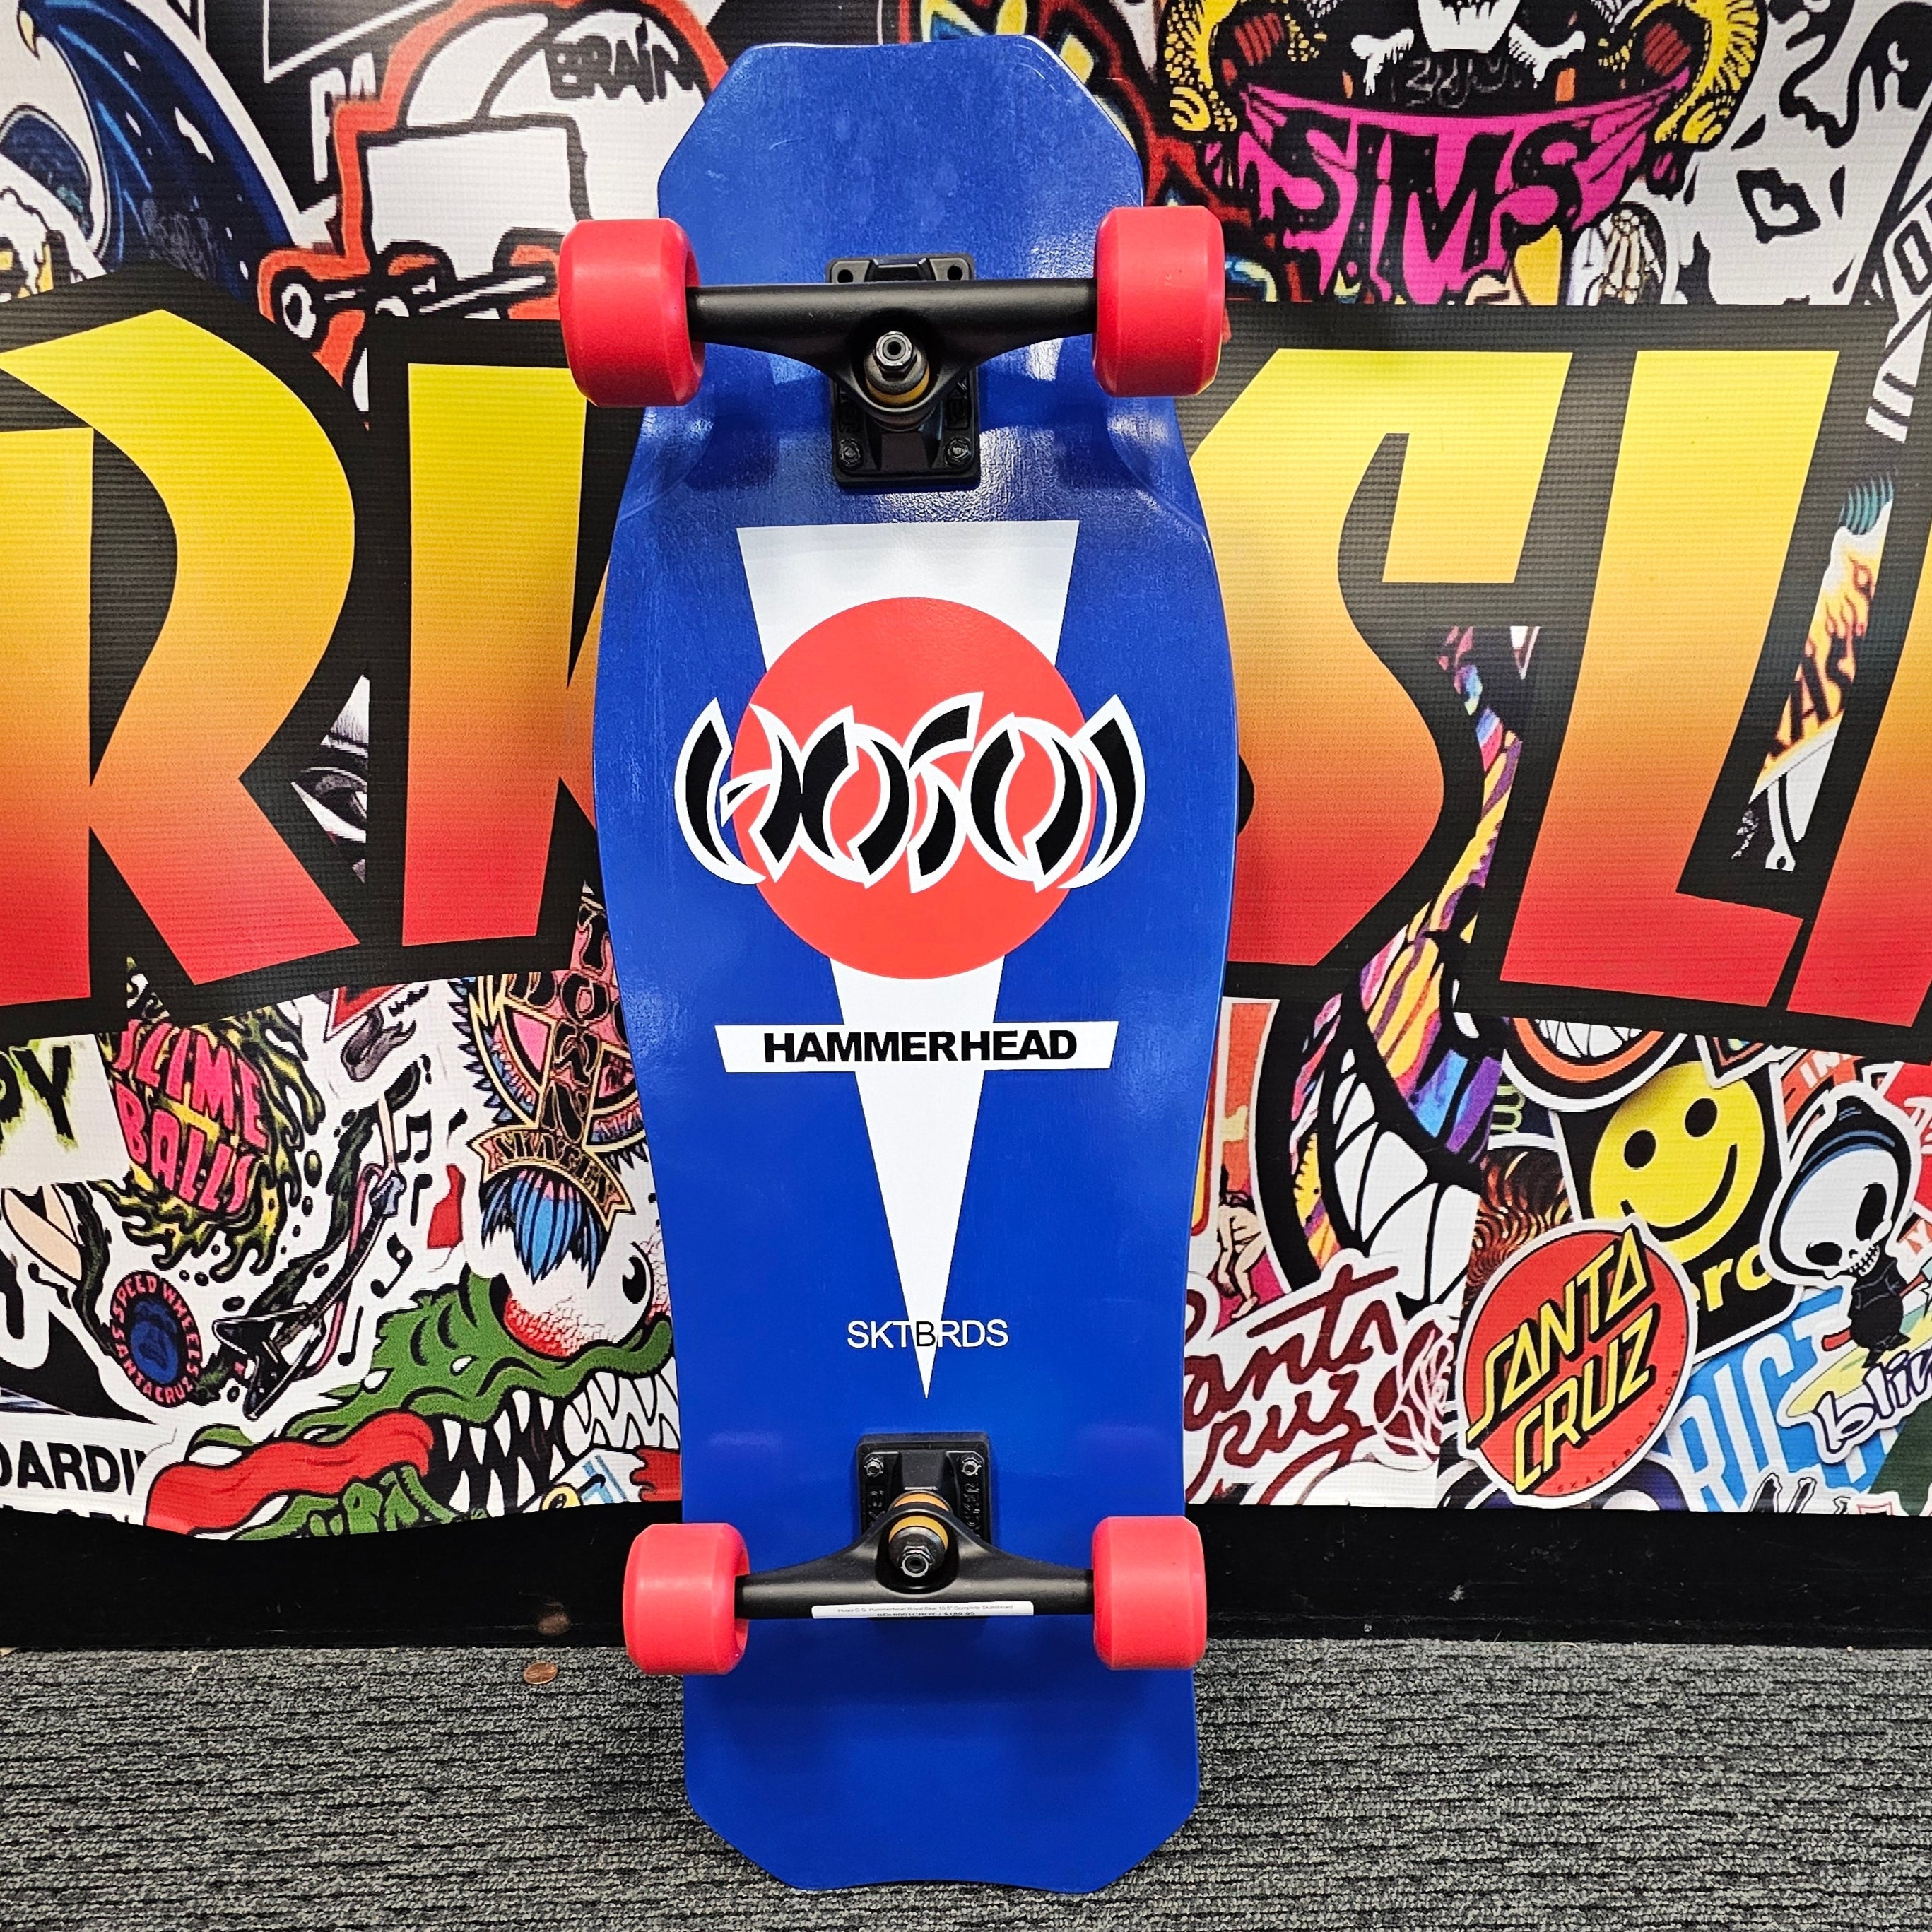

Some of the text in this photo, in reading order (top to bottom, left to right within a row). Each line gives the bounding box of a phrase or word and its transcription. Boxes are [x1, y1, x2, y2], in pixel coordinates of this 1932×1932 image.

[1268, 110, 1586, 304] SIMS
[674, 691, 1146, 893] HOSOI
[112, 1018, 269, 1150] SLIME
[764, 1030, 1078, 1063] HAMMERHEAD
[114, 1080, 256, 1214] BALLS
[112, 1274, 201, 1377] SPEED WHEELS
[154, 1376, 194, 1405] CRUZ
[847, 1319, 1009, 1348] SKTBRDS
[1465, 1227, 1649, 1445] SANTA
[1514, 1307, 1655, 1493] CRUZ
